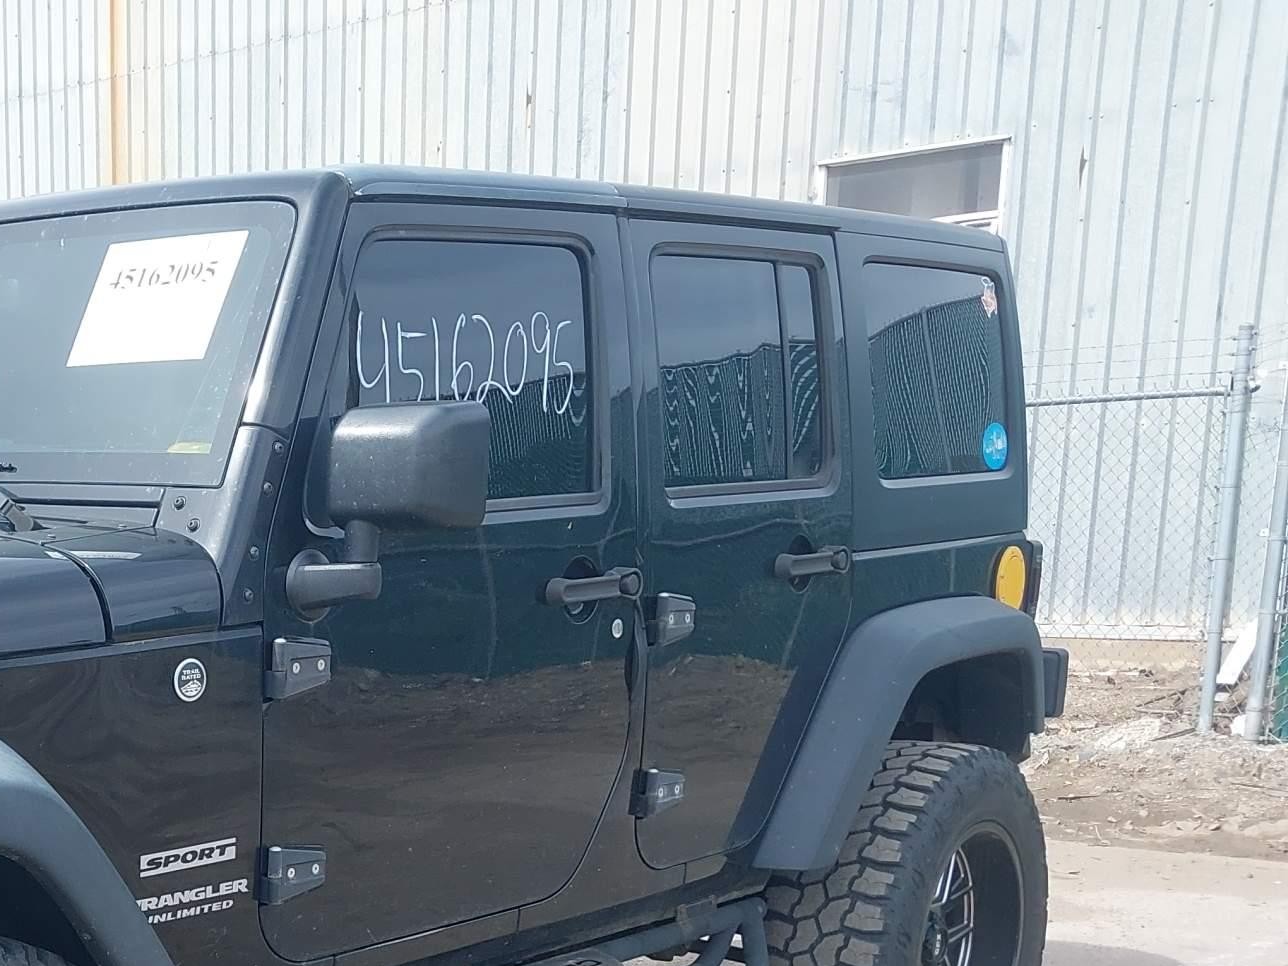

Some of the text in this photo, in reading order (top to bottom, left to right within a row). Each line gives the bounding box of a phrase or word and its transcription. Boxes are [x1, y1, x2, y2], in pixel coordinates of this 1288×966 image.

[109, 260, 219, 290] 45162095
[356, 311, 573, 415] 45162095
[142, 843, 233, 873] SPORT
[136, 879, 249, 911] RANGLER
